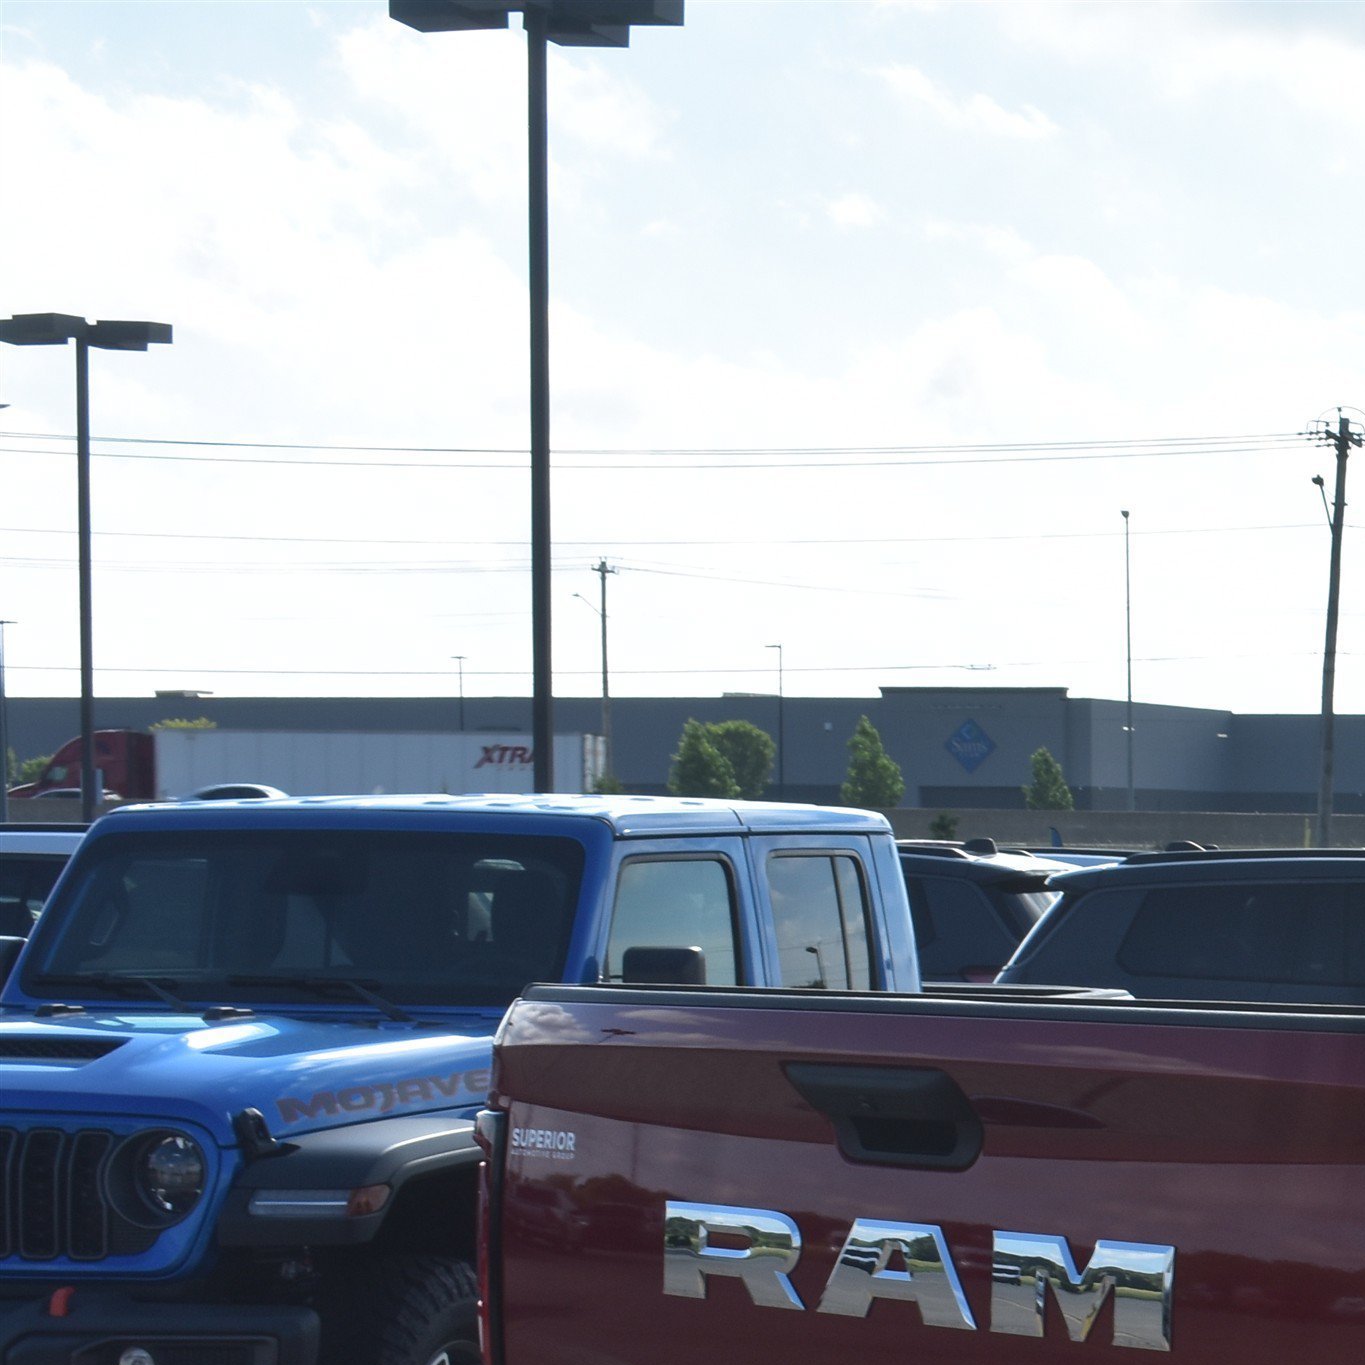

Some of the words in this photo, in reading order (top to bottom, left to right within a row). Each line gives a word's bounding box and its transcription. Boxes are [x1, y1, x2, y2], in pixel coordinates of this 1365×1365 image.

[275, 1068, 492, 1124] MOJAVE
[511, 1127, 577, 1151] SUPERIOR
[662, 1200, 1175, 1352] RAM
